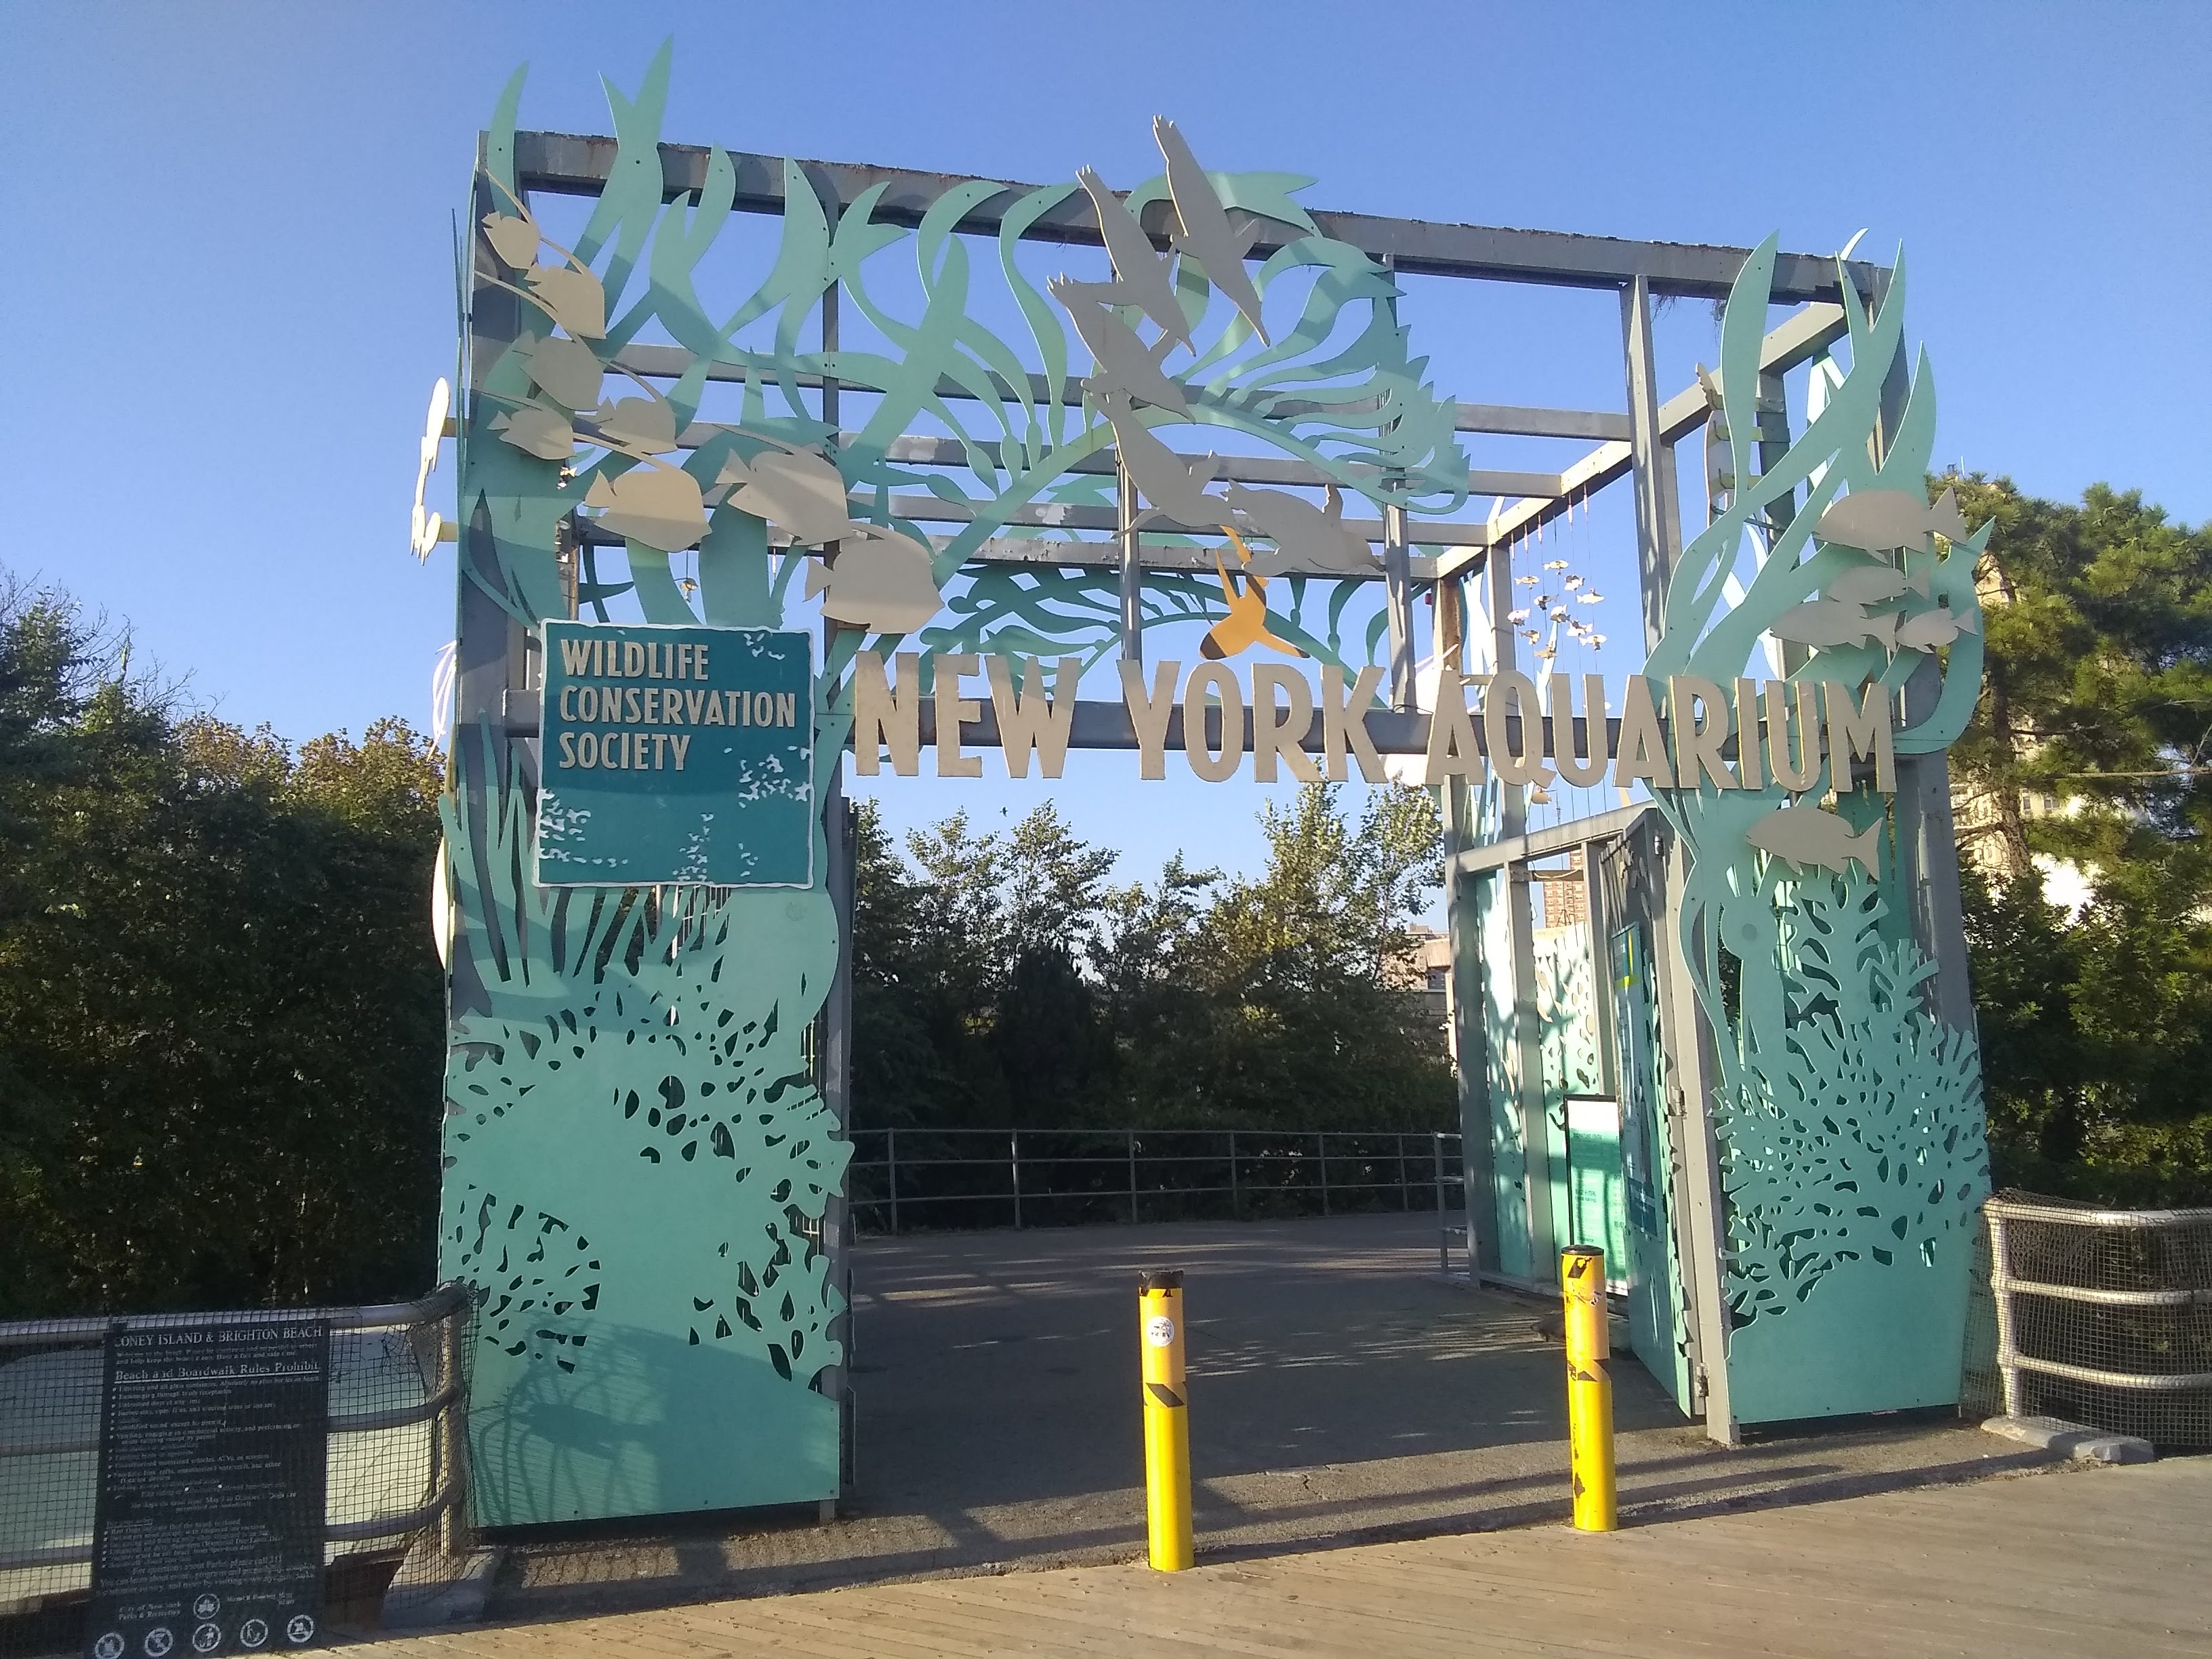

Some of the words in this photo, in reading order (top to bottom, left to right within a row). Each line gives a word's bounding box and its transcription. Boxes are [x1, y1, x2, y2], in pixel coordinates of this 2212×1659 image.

[561, 639, 709, 680] WILDLIFE
[560, 685, 796, 728] CONSERVATION
[855, 651, 1082, 779] NEW
[1116, 659, 1391, 783] YORK
[1426, 668, 1897, 793] AQUARIUM
[559, 732, 691, 771] SOCIETY
[158, 1332, 202, 1345] ISLAND
[206, 1332, 214, 1343] &
[218, 1328, 279, 1343] BRIGHTON
[283, 1326, 322, 1339] BEACH
[115, 1369, 148, 1380] Beach
[240, 1363, 270, 1374] Rules
